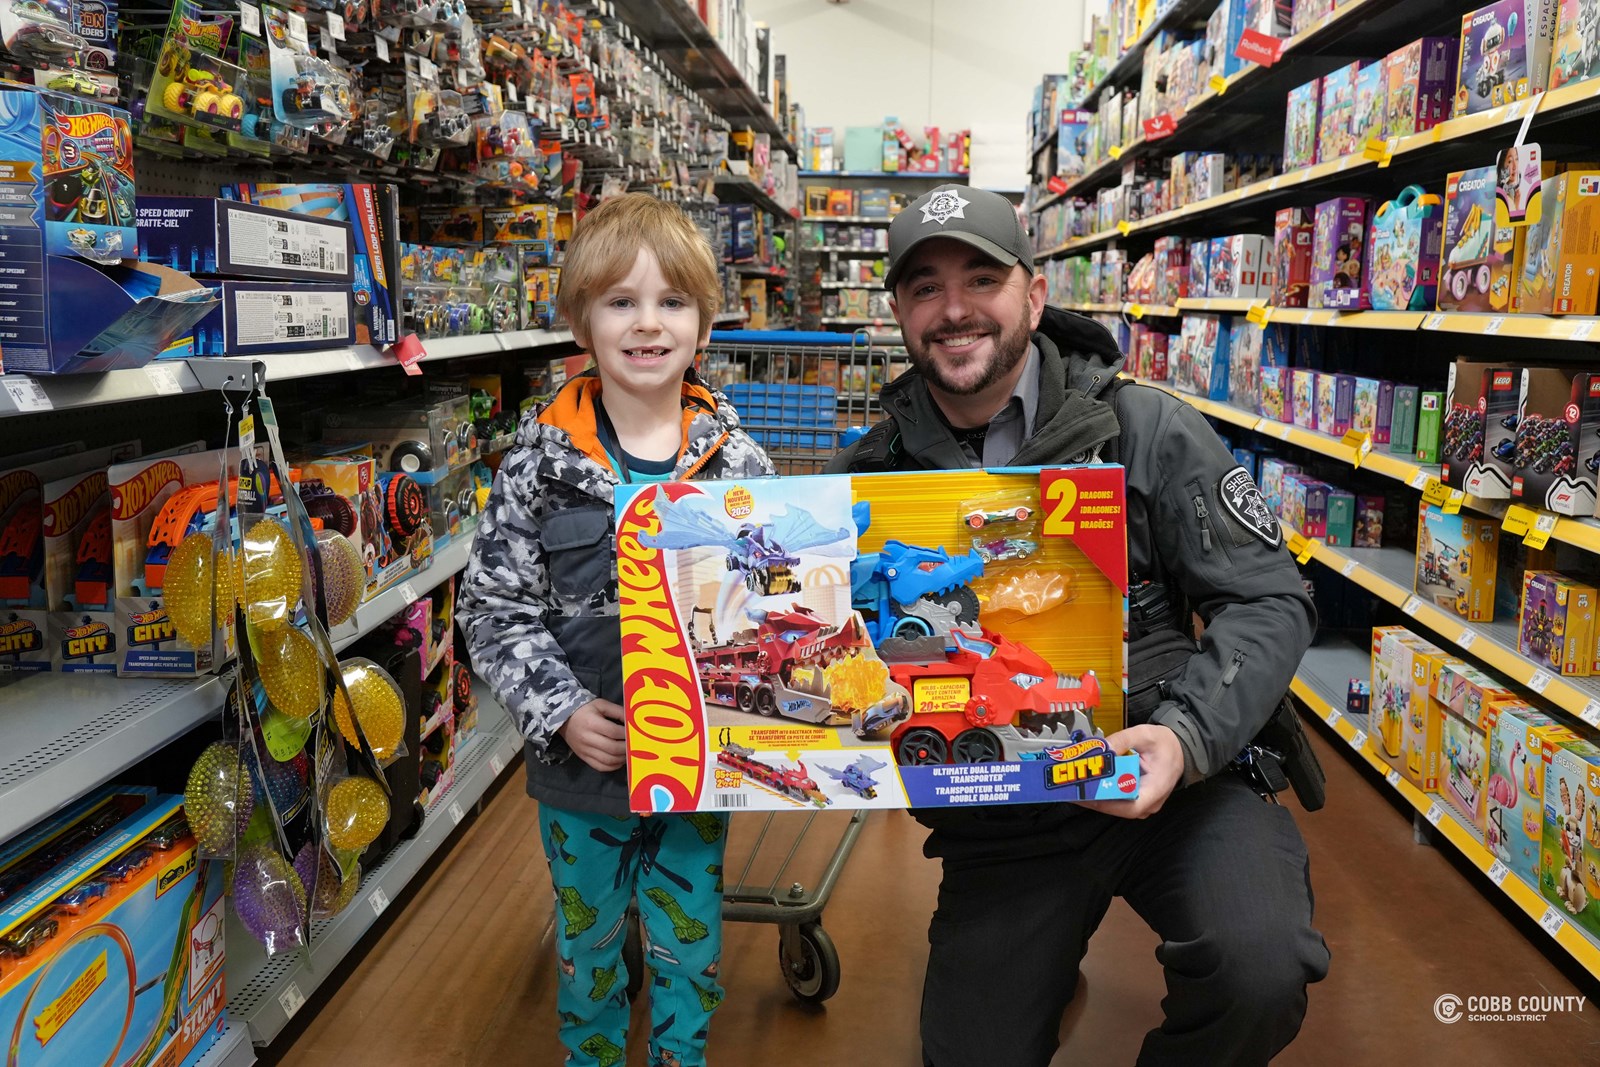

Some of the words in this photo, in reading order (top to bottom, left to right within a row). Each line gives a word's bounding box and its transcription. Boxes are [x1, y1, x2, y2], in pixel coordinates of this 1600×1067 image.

[1472, 11, 1495, 27] CREATOR
[1242, 38, 1272, 56] Rollback
[64, 144, 75, 157] 3
[1459, 179, 1487, 192] CREATOR
[140, 209, 161, 217] SPEED
[363, 187, 376, 233] CHALLENGE
[370, 233, 380, 254] LOOP
[374, 255, 384, 281] SUPER
[1563, 263, 1573, 296] CREATOR
[404, 352, 426, 367] Rollback
[1494, 377, 1511, 385] LEGO
[728, 494, 751, 503] NOUVEAU
[1080, 490, 1114, 499] DRAGONS!
[731, 505, 751, 517] 2025
[1043, 478, 1077, 535] 2
[1507, 515, 1528, 526] Clearance
[1527, 533, 1545, 545] Clearance
[1531, 580, 1547, 592] CREATOR
[134, 621, 175, 642] CITY
[68, 635, 109, 656] CITY
[920, 701, 940, 712] 20+
[1498, 718, 1522, 737] CREATOR
[933, 767, 968, 776] ULTIMATE
[970, 766, 989, 774] DUAL
[991, 764, 1021, 773] DRAGON
[1052, 755, 1104, 785] CITY
[1553, 753, 1582, 777] CREATOR
[935, 785, 993, 795] TRANSPORTEUR
[994, 784, 1021, 793] ULTIME
[1102, 779, 1113, 789] 4+
[1118, 778, 1137, 788] MATTEL
[949, 794, 978, 803] DOUBLE
[979, 793, 1009, 802] DRAGON
[184, 976, 223, 1043] STUNT
[192, 1010, 216, 1043] TRACKS
